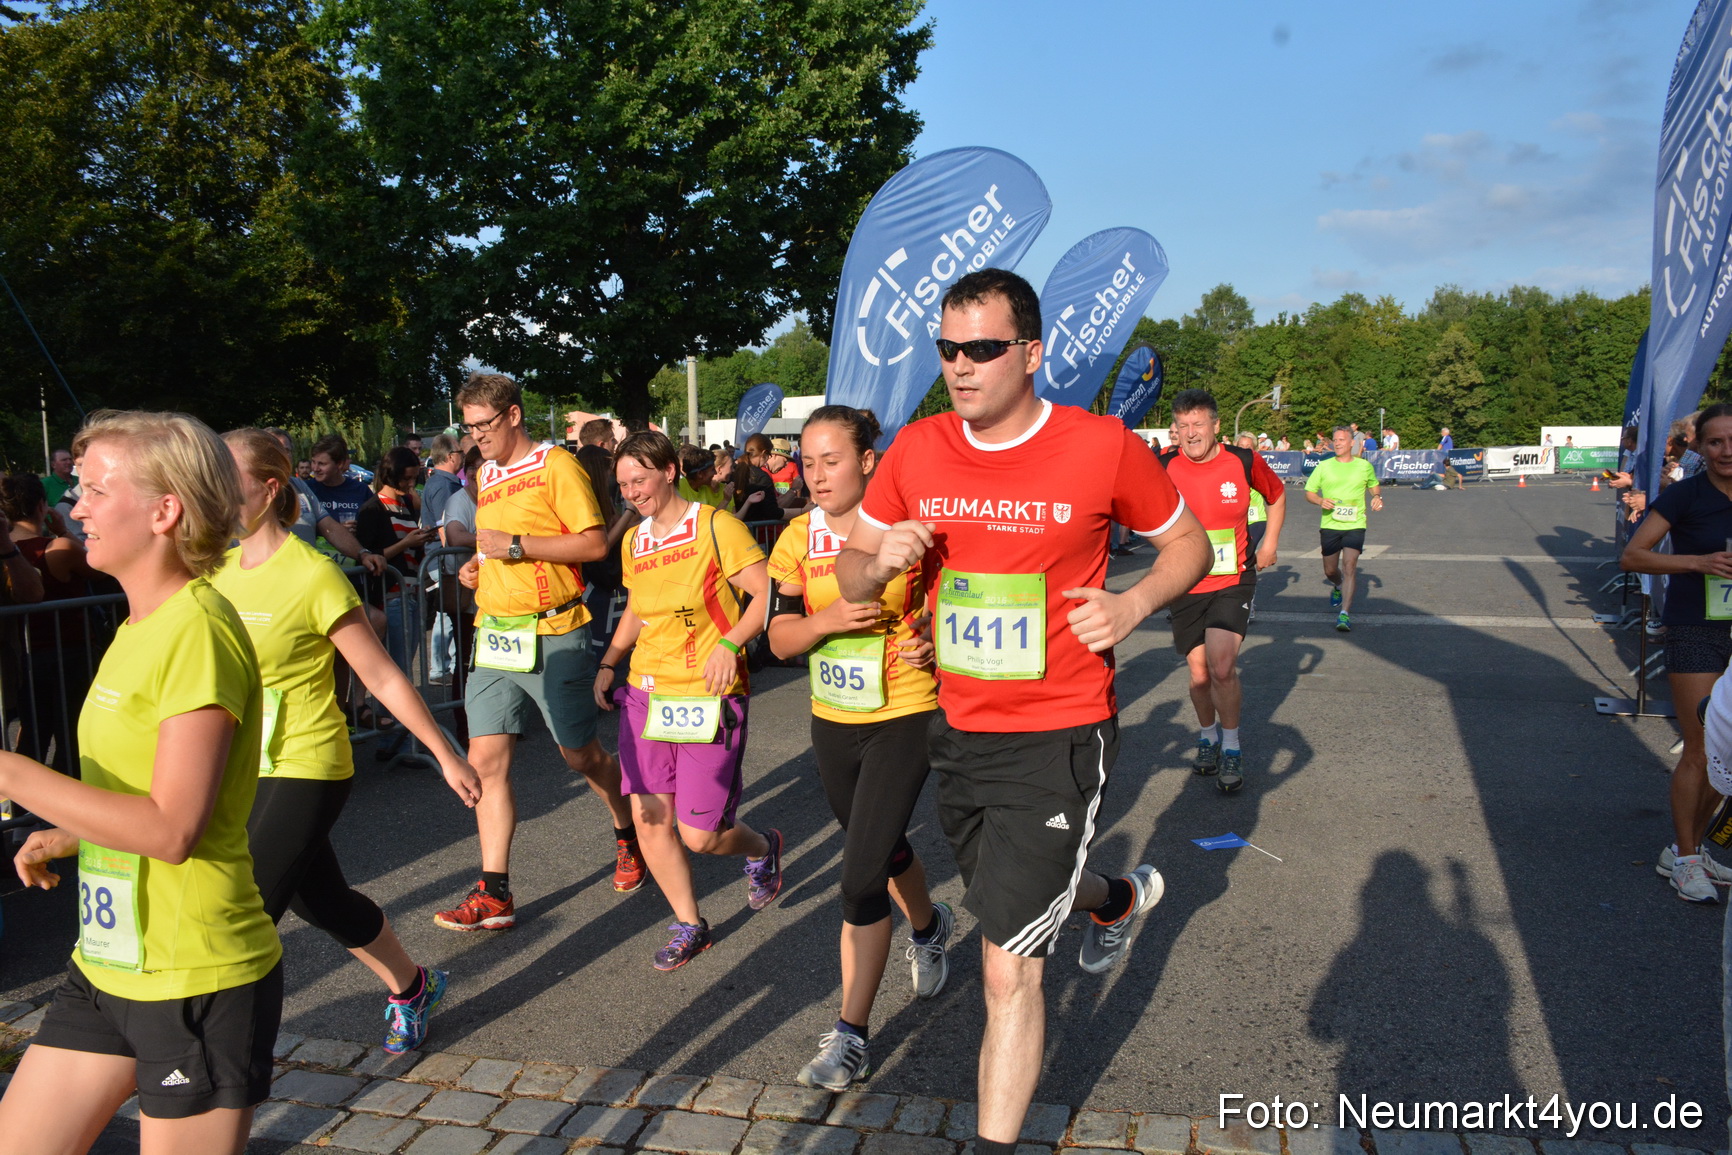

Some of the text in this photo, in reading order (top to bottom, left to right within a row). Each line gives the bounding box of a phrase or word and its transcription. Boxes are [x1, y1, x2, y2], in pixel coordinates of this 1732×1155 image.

[1680, 30, 1732, 275] Fische
[885, 184, 1004, 340] Fischer
[926, 213, 1016, 339] AUOBILE
[1061, 252, 1136, 370] Fischer
[1088, 273, 1146, 367] AUTOMOBILE
[747, 390, 774, 427] Fischer
[1111, 383, 1146, 419] schmann
[1268, 461, 1291, 469] scher
[1393, 460, 1434, 471] Fischer
[1513, 452, 1539, 466] swn
[1564, 450, 1584, 461] AOK
[507, 475, 546, 497] BÖGL
[920, 498, 1047, 521] NEUMARKT
[1336, 507, 1353, 516] 226
[987, 524, 1045, 534] STARKE STADT
[634, 547, 698, 575] MAX BÖGL
[810, 563, 836, 579] MA
[946, 612, 1028, 650] 1411
[487, 633, 522, 654] 931
[986, 658, 1003, 666] Vogt
[820, 660, 865, 691] 895
[662, 706, 705, 728] 933
[1045, 820, 1070, 830] adidas
[86, 936, 111, 948] Maurer
[161, 1077, 190, 1086] adidas
